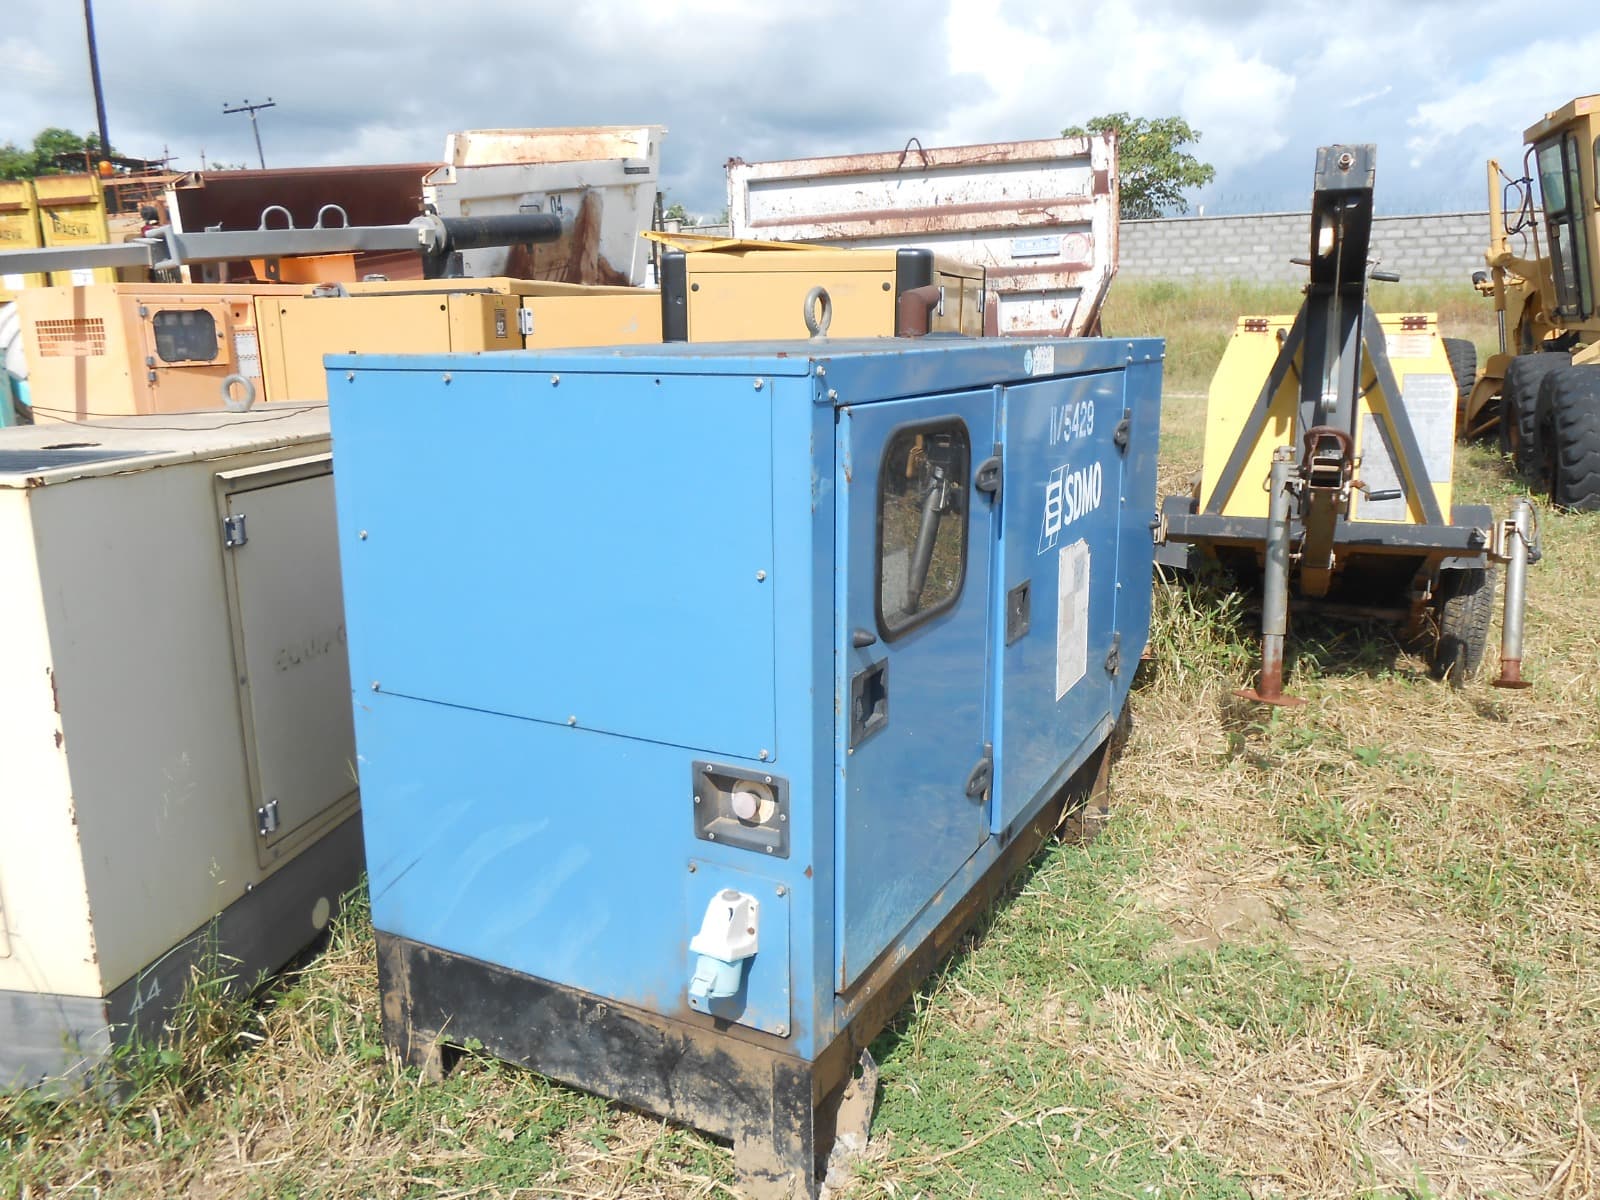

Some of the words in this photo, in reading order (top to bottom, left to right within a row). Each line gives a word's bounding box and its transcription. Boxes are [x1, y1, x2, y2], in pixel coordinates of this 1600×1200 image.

[550, 193, 563, 216] 04
[1064, 461, 1103, 526] SDMO
[129, 977, 162, 1016] 44
